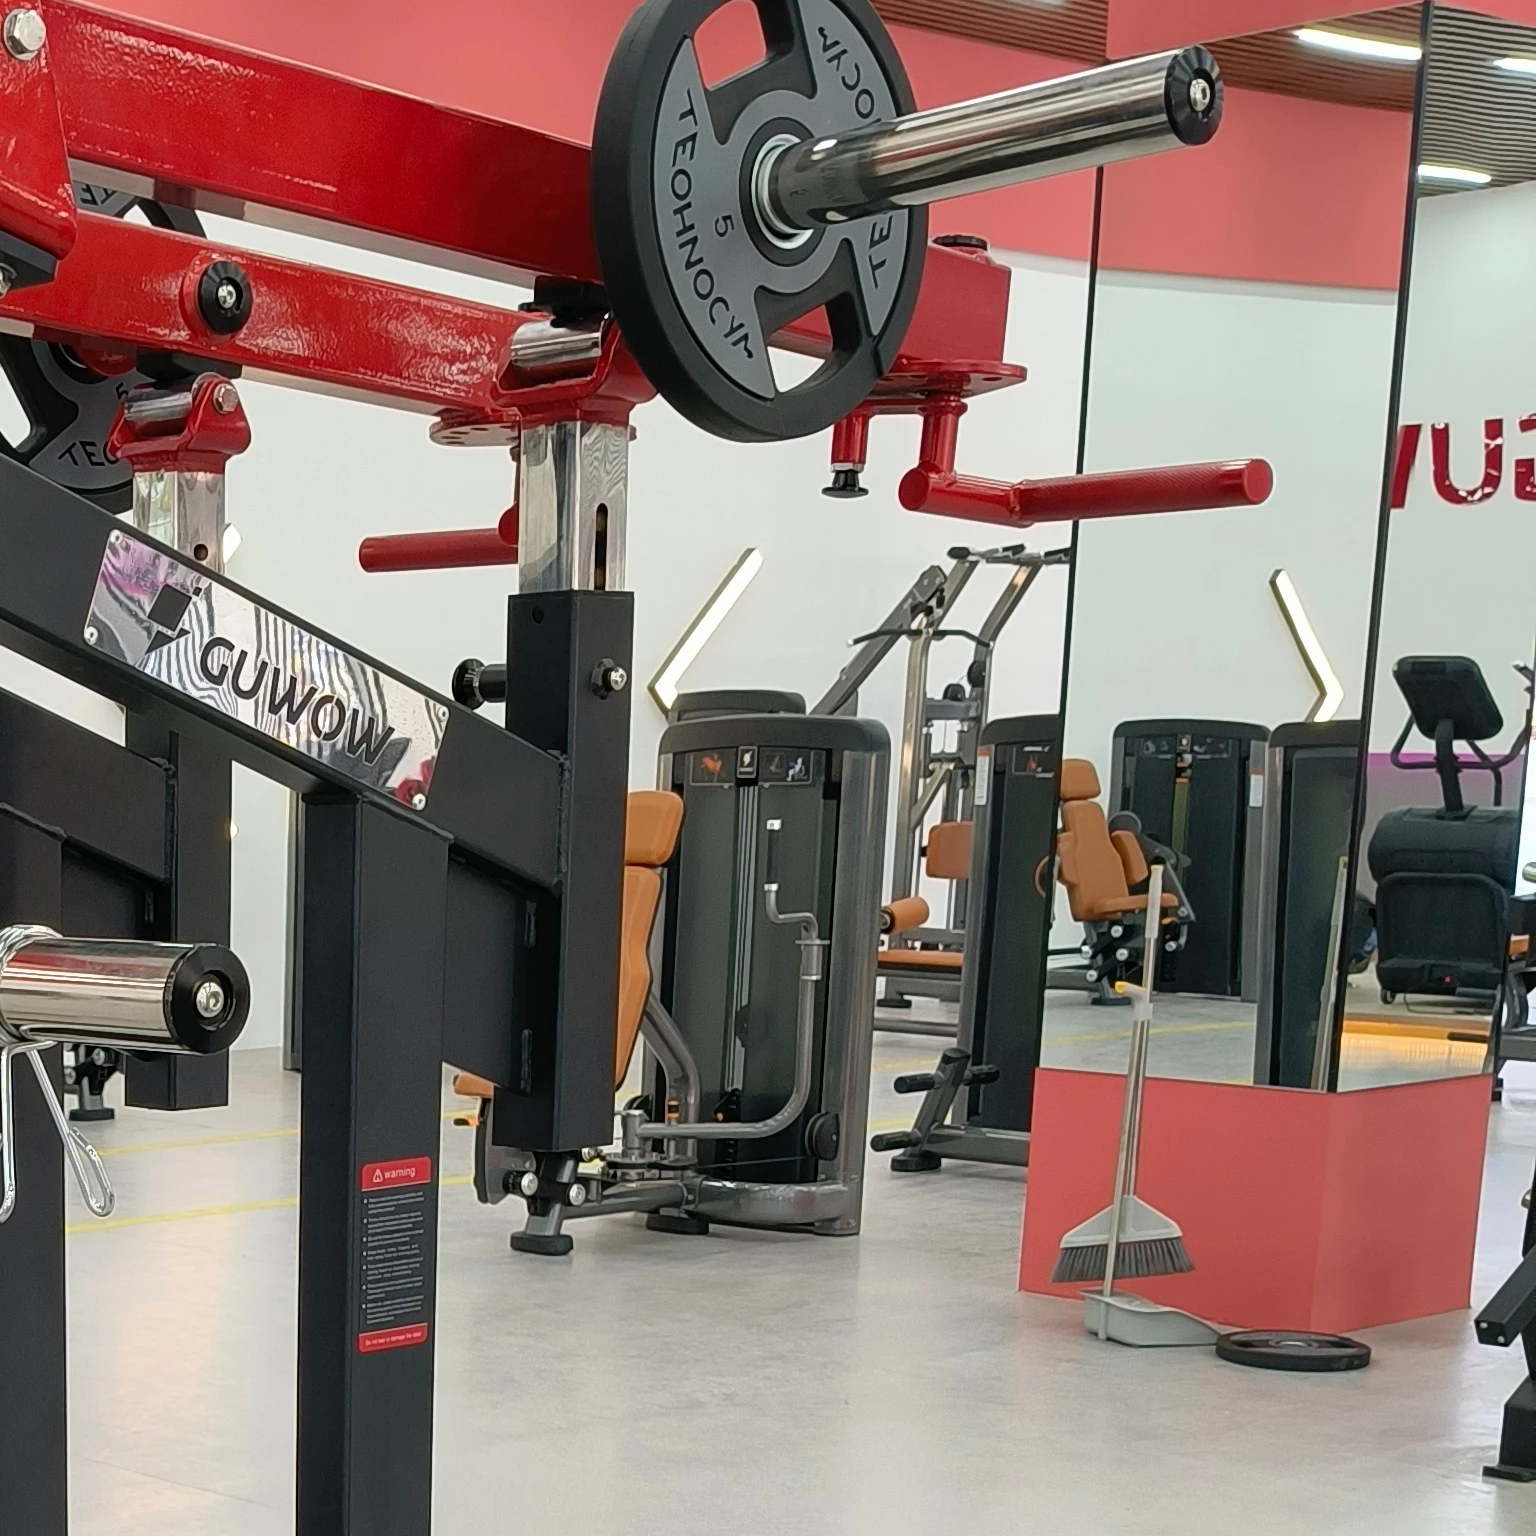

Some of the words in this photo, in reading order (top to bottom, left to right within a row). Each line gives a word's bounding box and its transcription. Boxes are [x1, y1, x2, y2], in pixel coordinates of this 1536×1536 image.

[713, 214, 736, 239] 5
[200, 636, 396, 766] GUWOW
[384, 1167, 416, 1179] warning
